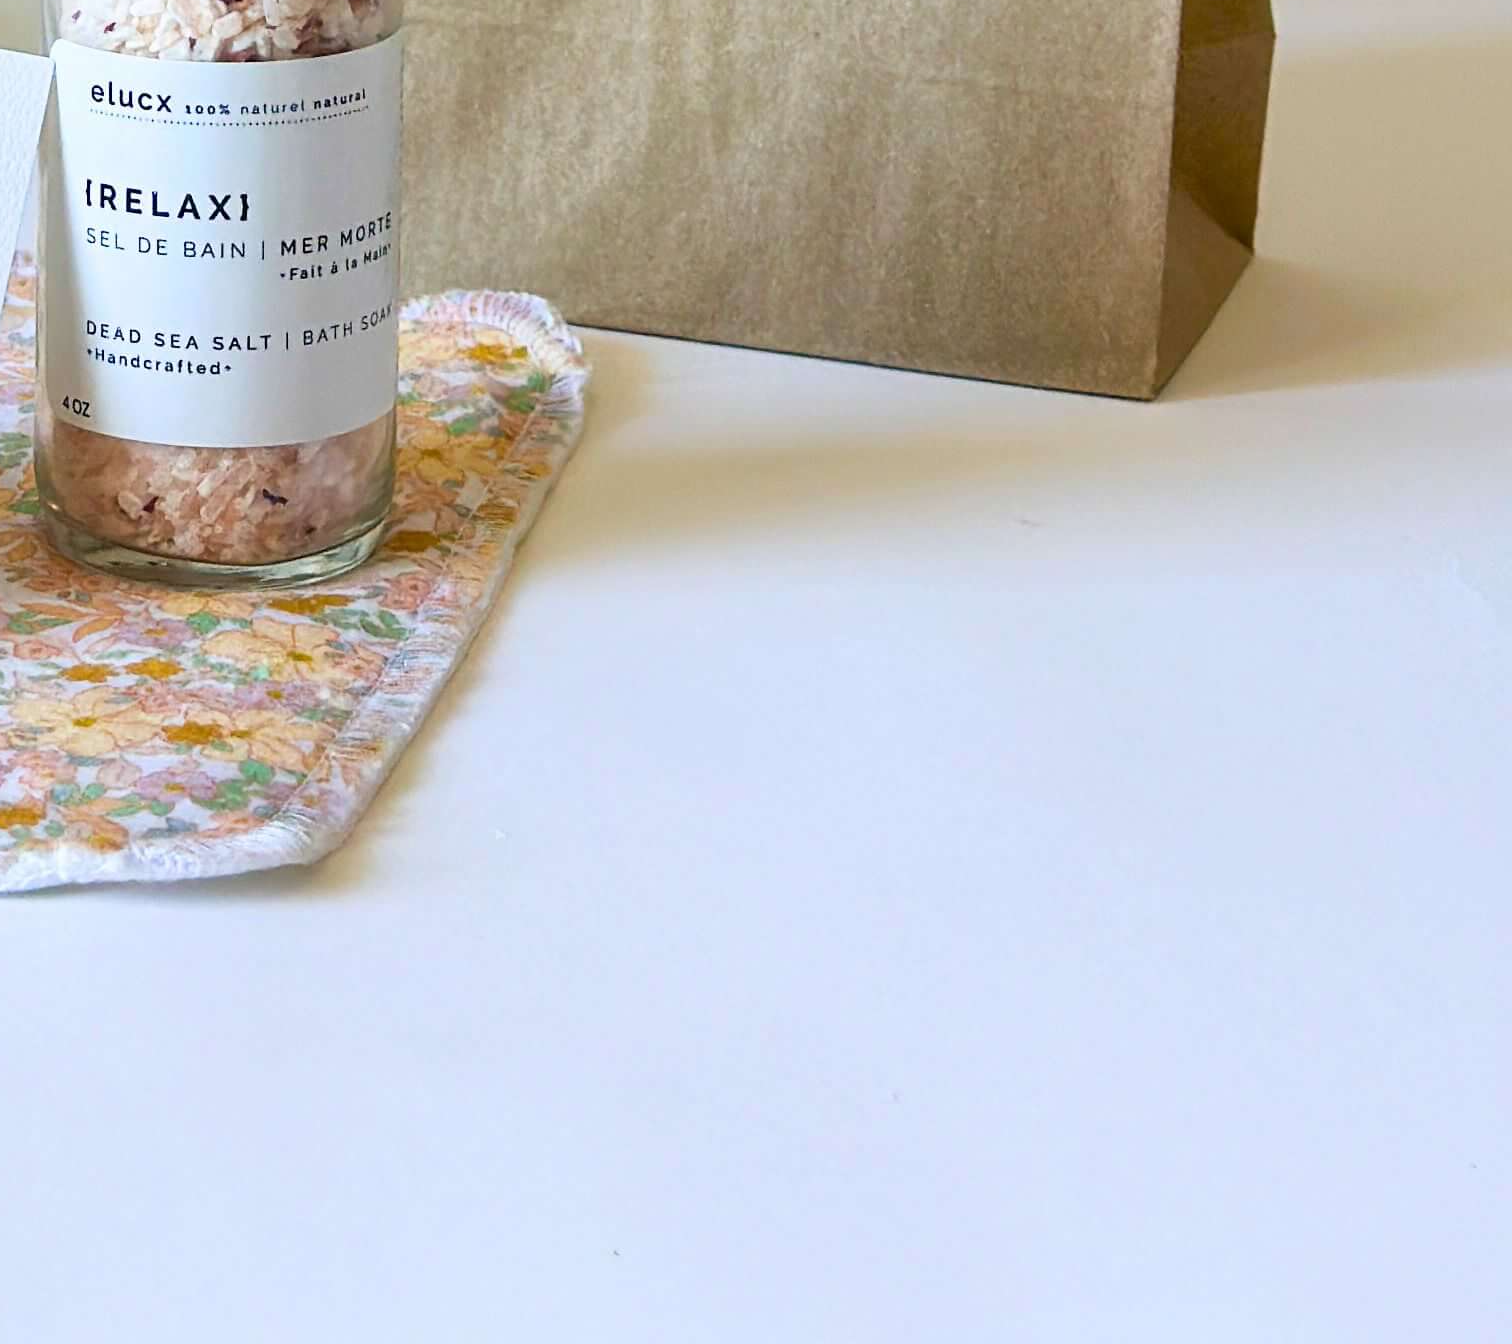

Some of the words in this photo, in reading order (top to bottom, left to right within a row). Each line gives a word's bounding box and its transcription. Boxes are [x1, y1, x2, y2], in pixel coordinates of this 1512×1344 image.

[91, 81, 172, 113] elucx
[186, 103, 231, 115] 100%
[240, 99, 304, 115] naturel
[313, 88, 366, 110] natural
[85, 178, 249, 222] {RELAX}
[87, 227, 125, 250] SEL
[138, 237, 168, 256] DE
[183, 240, 246, 258] BAIN
[281, 235, 328, 256] MER
[340, 211, 391, 248] MORTE
[346, 258, 358, 271] la
[87, 320, 141, 343] DEAD
[154, 333, 199, 350] SEA
[213, 335, 272, 351] SALT
[303, 322, 353, 346] BATH
